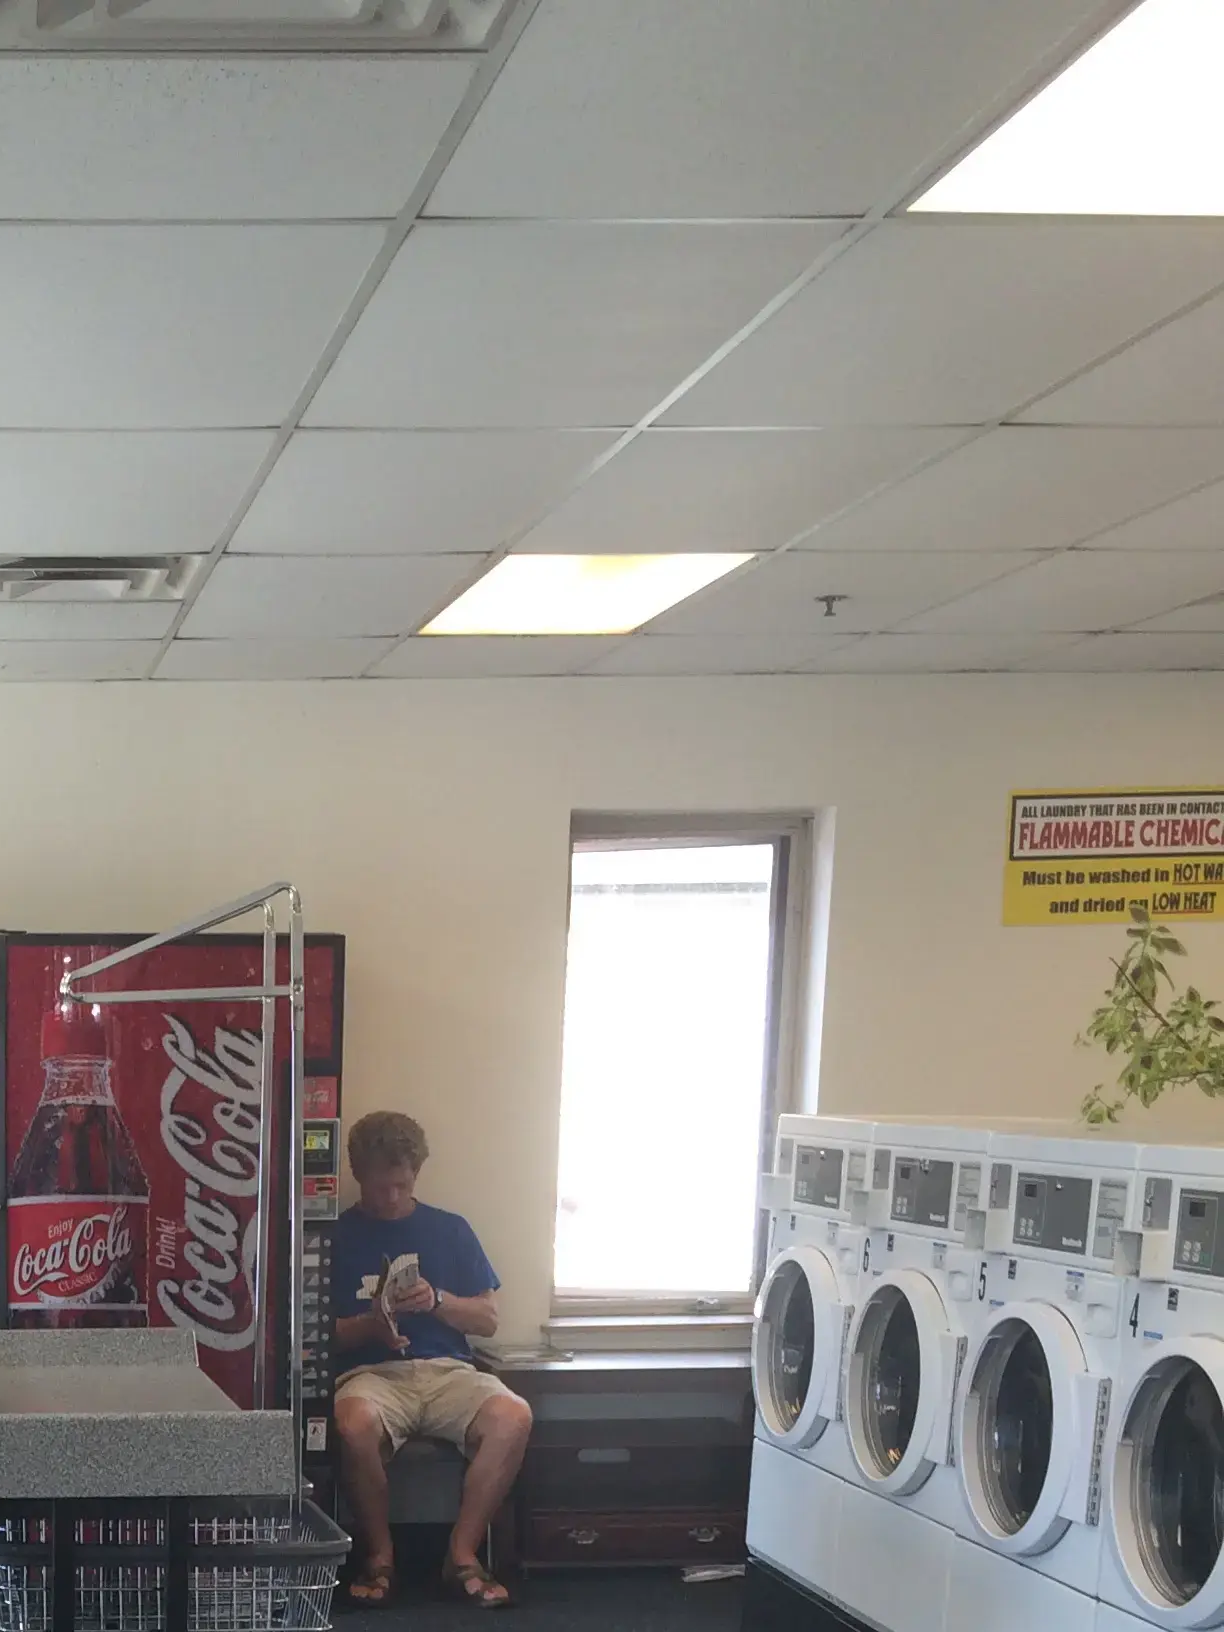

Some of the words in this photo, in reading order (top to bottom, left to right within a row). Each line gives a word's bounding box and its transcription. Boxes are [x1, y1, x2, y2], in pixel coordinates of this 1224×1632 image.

[1021, 806, 1038, 818] ALL
[1040, 805, 1087, 818] LAUNDRY
[1089, 804, 1115, 816] THAT
[1116, 803, 1137, 816] HAS
[1139, 803, 1165, 816] BEEN
[1166, 803, 1178, 815] IN
[1018, 820, 1135, 850] FLAMMABLE
[1022, 871, 1062, 886] Must
[1065, 870, 1085, 885] be
[1088, 868, 1151, 884] washed
[1154, 868, 1170, 882] in
[1173, 863, 1201, 881] HOT
[1049, 899, 1079, 914] and
[1082, 897, 1125, 912] dried
[1151, 893, 1181, 910] LOW
[1183, 892, 1217, 909] HEAT
[156, 1012, 264, 1351] Coca-Cola
[48, 1218, 74, 1239] Enjoy
[155, 1216, 177, 1270] Drink!
[13, 1205, 132, 1296] Coca-Cola
[863, 1237, 871, 1272] 6
[57, 1271, 99, 1293] CLASSIC
[978, 1262, 987, 1300] 5
[1129, 1293, 1140, 1338] 4
